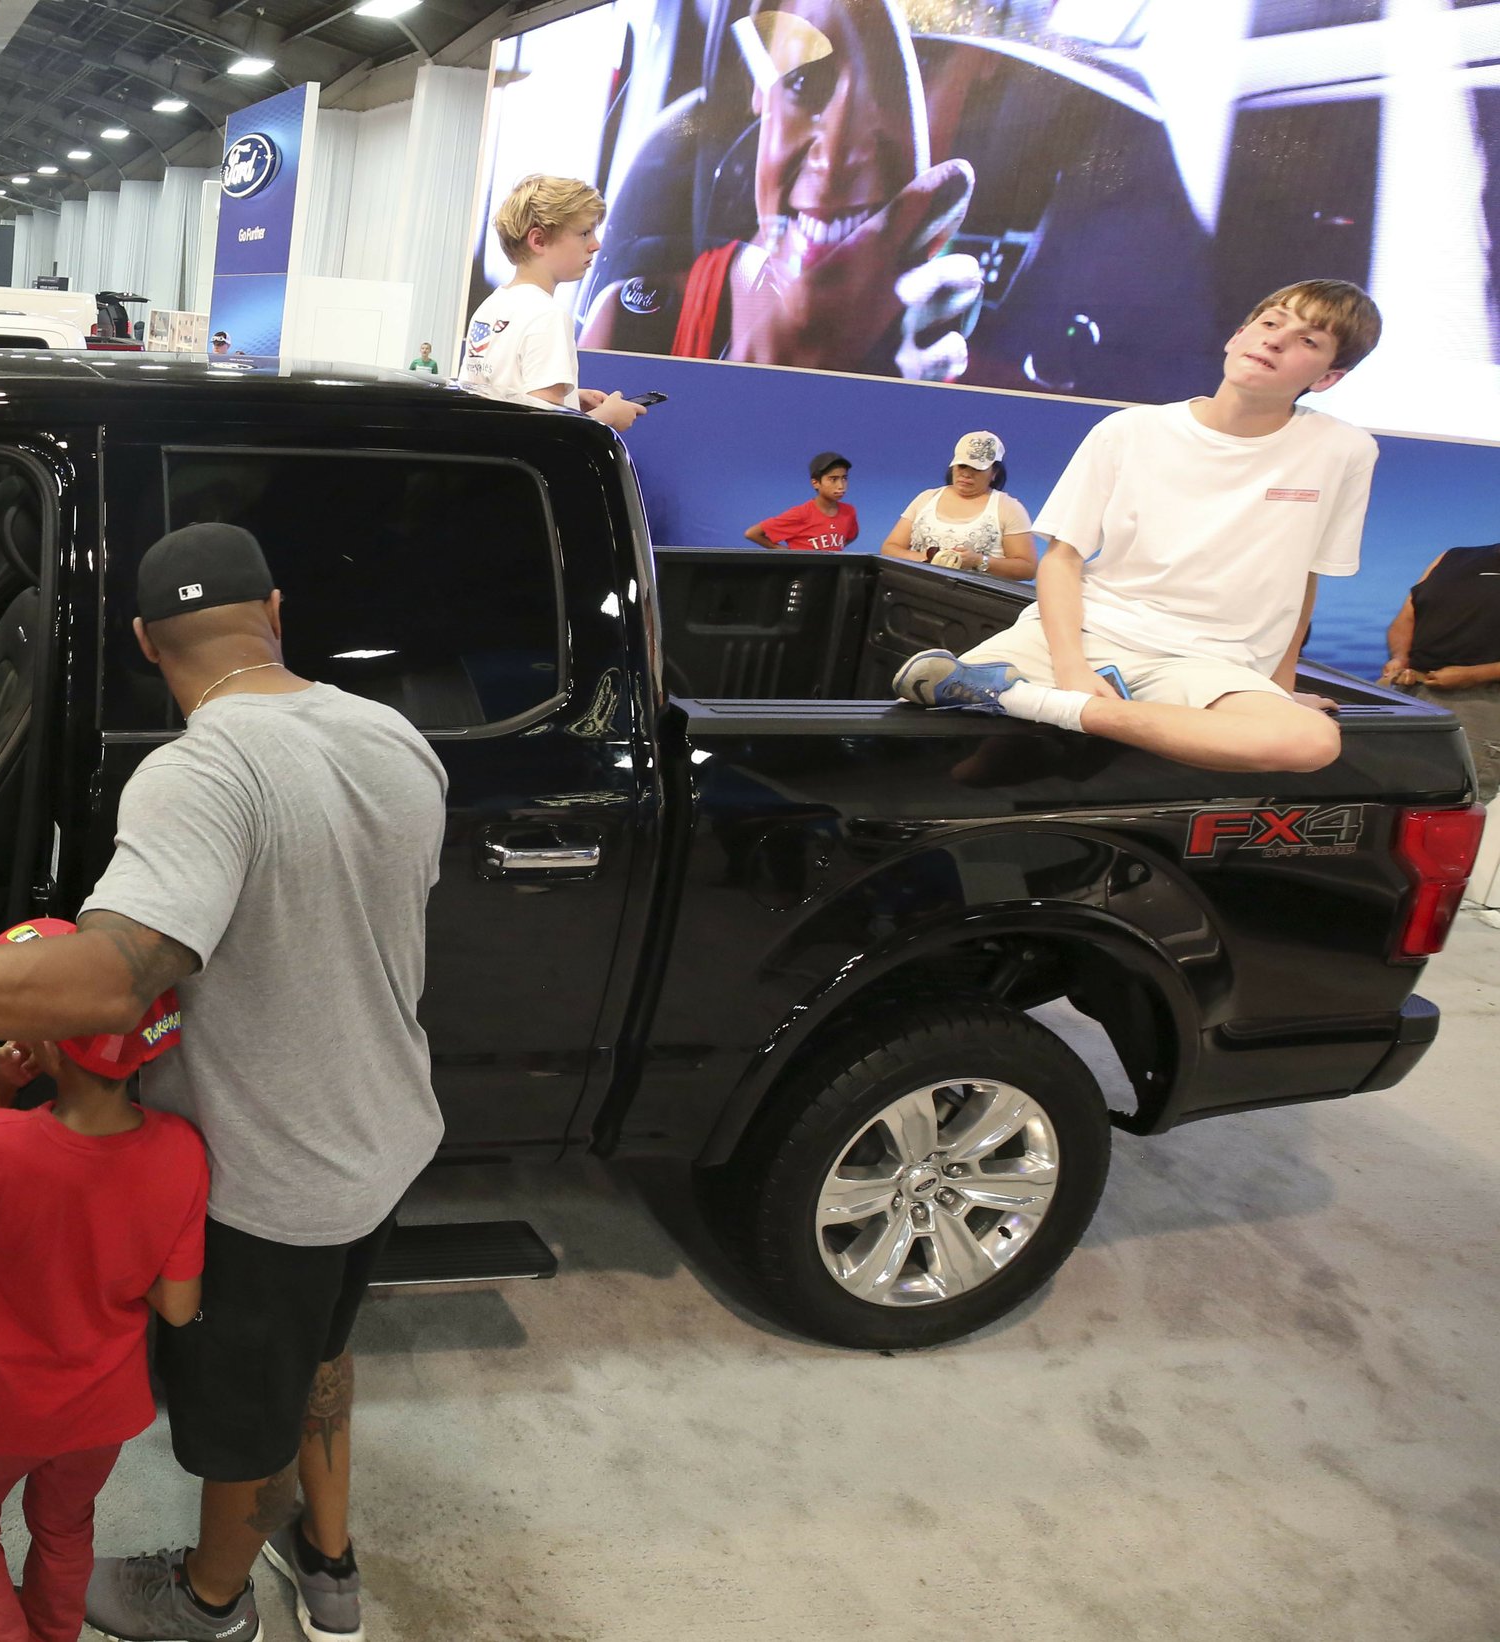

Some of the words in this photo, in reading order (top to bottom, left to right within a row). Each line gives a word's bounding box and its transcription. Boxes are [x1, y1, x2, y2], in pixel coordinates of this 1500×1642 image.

[224, 143, 258, 187] Ford
[238, 228, 248, 242] Go
[247, 226, 266, 241] Further
[807, 533, 845, 550] TEXA
[1184, 804, 1364, 859] FX4
[1261, 848, 1300, 858] OFF
[1305, 846, 1357, 857] ROAD
[215, 1618, 248, 1640] Reebok
